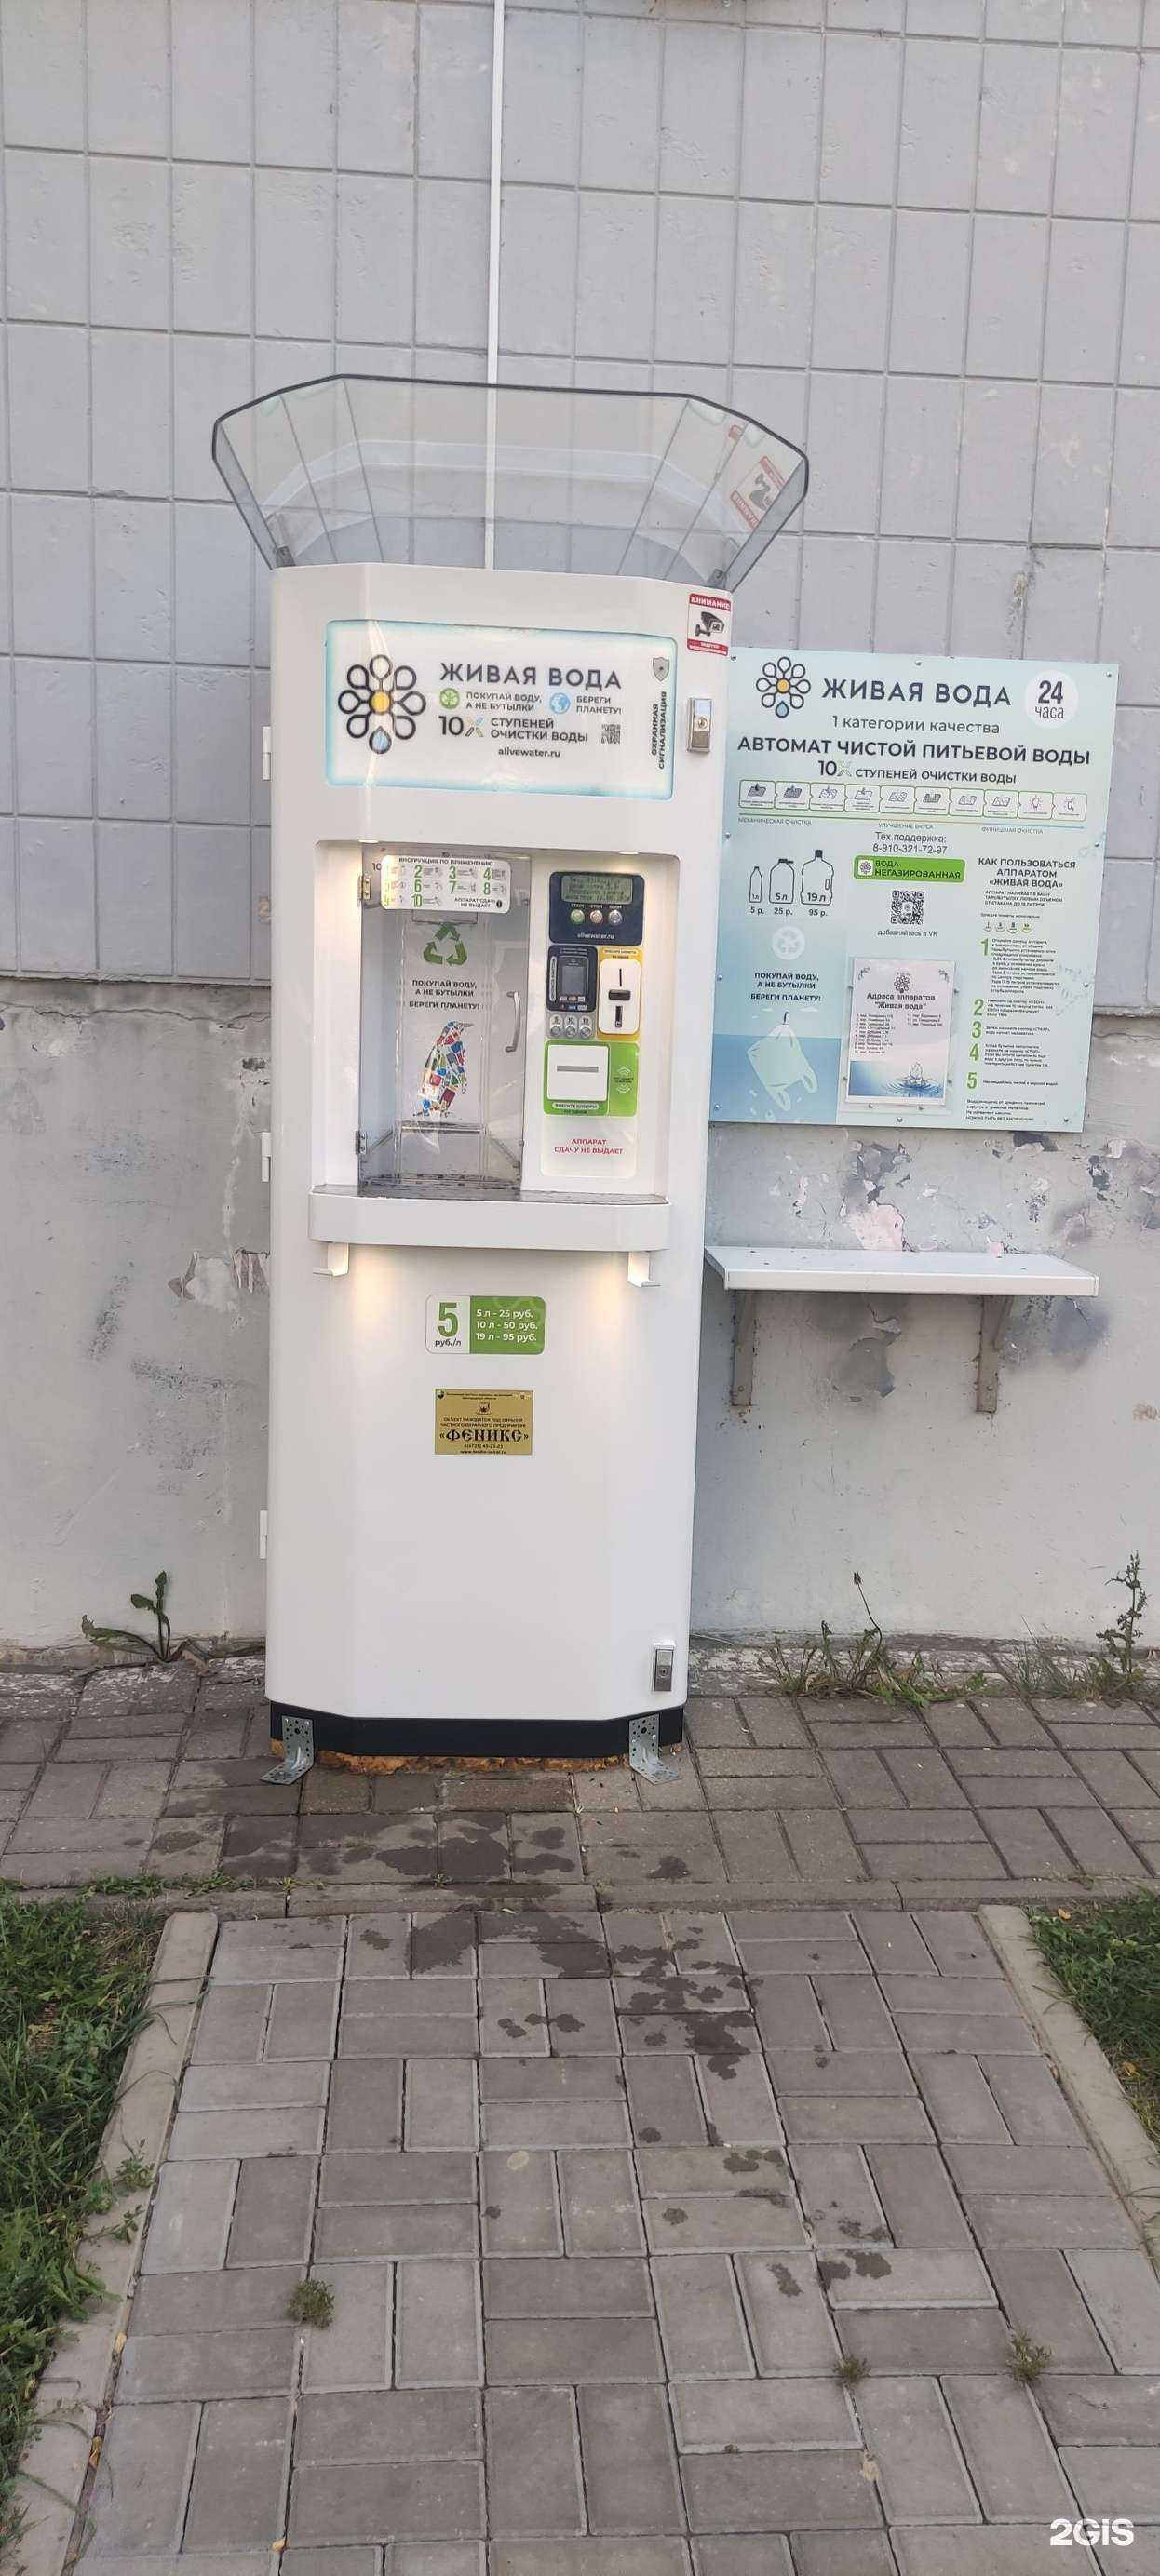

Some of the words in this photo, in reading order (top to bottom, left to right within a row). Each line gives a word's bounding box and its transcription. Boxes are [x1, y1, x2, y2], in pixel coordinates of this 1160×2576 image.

[440, 663, 536, 685] ЖИВАЯ
[548, 668, 621, 691] ВОДА
[466, 691, 512, 701] ПОКУПАЙ
[514, 693, 542, 704] ВОДУ,
[822, 678, 923, 702] ЖИВАЯ
[936, 683, 1011, 707] ВОДА
[1037, 680, 1064, 704] 24
[576, 696, 611, 704] БЕРЕГИ
[490, 704, 534, 712] БУТЫЛКИ
[576, 705, 622, 715] ПЛАНЕТУ!
[1034, 706, 1064, 719] часа
[491, 718, 554, 729] СТУПЕНЕЙ
[651, 703, 659, 756] ОХРАННАЯ
[832, 716, 838, 728] 1
[843, 718, 924, 732] категории
[930, 721, 1000, 734] качества
[491, 729, 547, 741] ОЧИСТКИ
[551, 731, 588, 742] ВОДЫ
[659, 691, 668, 770] СИГНАЛИЗАЦИЯ
[498, 747, 560, 758] alivewater.ru
[737, 736, 832, 754] АВТОМАТ
[837, 740, 916, 758] ЧИСТОЙ
[923, 744, 1026, 762] ПИТЬЕВОЙ
[1032, 748, 1090, 767] ВОДЫ
[856, 769, 917, 780] СТУПЕНЕЙ
[921, 770, 977, 782] ОЧИСТКИ
[980, 772, 1017, 785] ВОДЫ
[873, 843, 948, 854] 8-910-321-72-97
[978, 857, 997, 865] КАК
[1000, 858, 1076, 869] ПОЛЬЗОВАТЬСЯ
[414, 865, 423, 878] 2
[449, 866, 456, 879] 3
[483, 867, 492, 880] 4
[875, 869, 961, 879] НЕГАЗИРОВАННАЯ
[996, 868, 1058, 878] АППАРАТОМ
[414, 879, 422, 892] 6
[449, 880, 456, 894] 7
[483, 882, 491, 895] 8
[989, 878, 1029, 887] «ЖИВАЯ
[1031, 879, 1063, 889] ВОДА»
[411, 894, 423, 907] 10
[808, 908, 818, 917] 95
[980, 938, 989, 957] 1
[754, 972, 793, 980] ПОКУПАЙ
[412, 979, 452, 987] ПОКУПАЙ
[453, 981, 478, 989] ВОДУ,
[782, 994, 821, 1002] ПЛАНЕТУ!
[867, 992, 894, 1000] Адреса
[440, 1001, 480, 1010] ПЛАНЕТУ!
[974, 999, 984, 1016] 2
[972, 1021, 982, 1038] 3
[969, 1043, 979, 1061] 4
[967, 1072, 978, 1089] 5
[438, 1302, 459, 1338] 5
[476, 1308, 482, 1318] 5
[483, 1309, 491, 1318] л
[499, 1309, 510, 1318] 25
[513, 1309, 533, 1320] руб.
[476, 1321, 486, 1329] 10
[503, 1321, 516, 1330] 50
[518, 1322, 538, 1331] руб.
[435, 1337, 462, 1348] руб./л
[476, 1332, 486, 1341] 19
[502, 1333, 514, 1341] 95
[517, 1333, 537, 1343] руб.
[439, 1429, 529, 1442] «ФЕНИКС»
